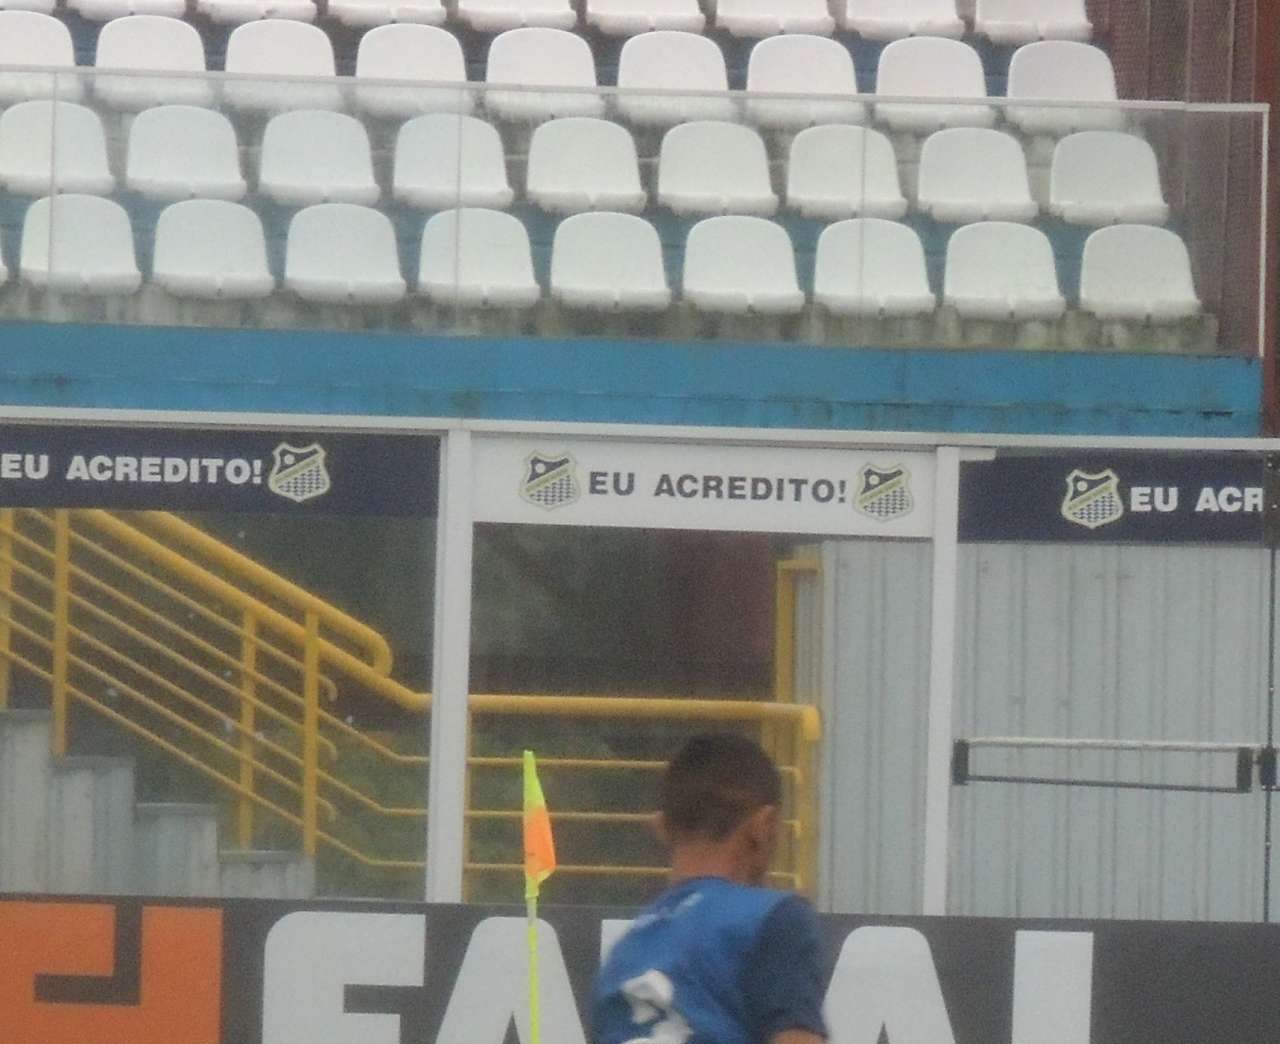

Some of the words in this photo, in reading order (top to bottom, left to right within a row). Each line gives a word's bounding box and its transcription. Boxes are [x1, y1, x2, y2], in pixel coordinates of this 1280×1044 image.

[0, 454, 48, 480] EU
[65, 455, 262, 485] ACREDITO!
[589, 471, 635, 496] EU
[654, 473, 847, 504] ACREDITO!
[1130, 487, 1178, 512] EU
